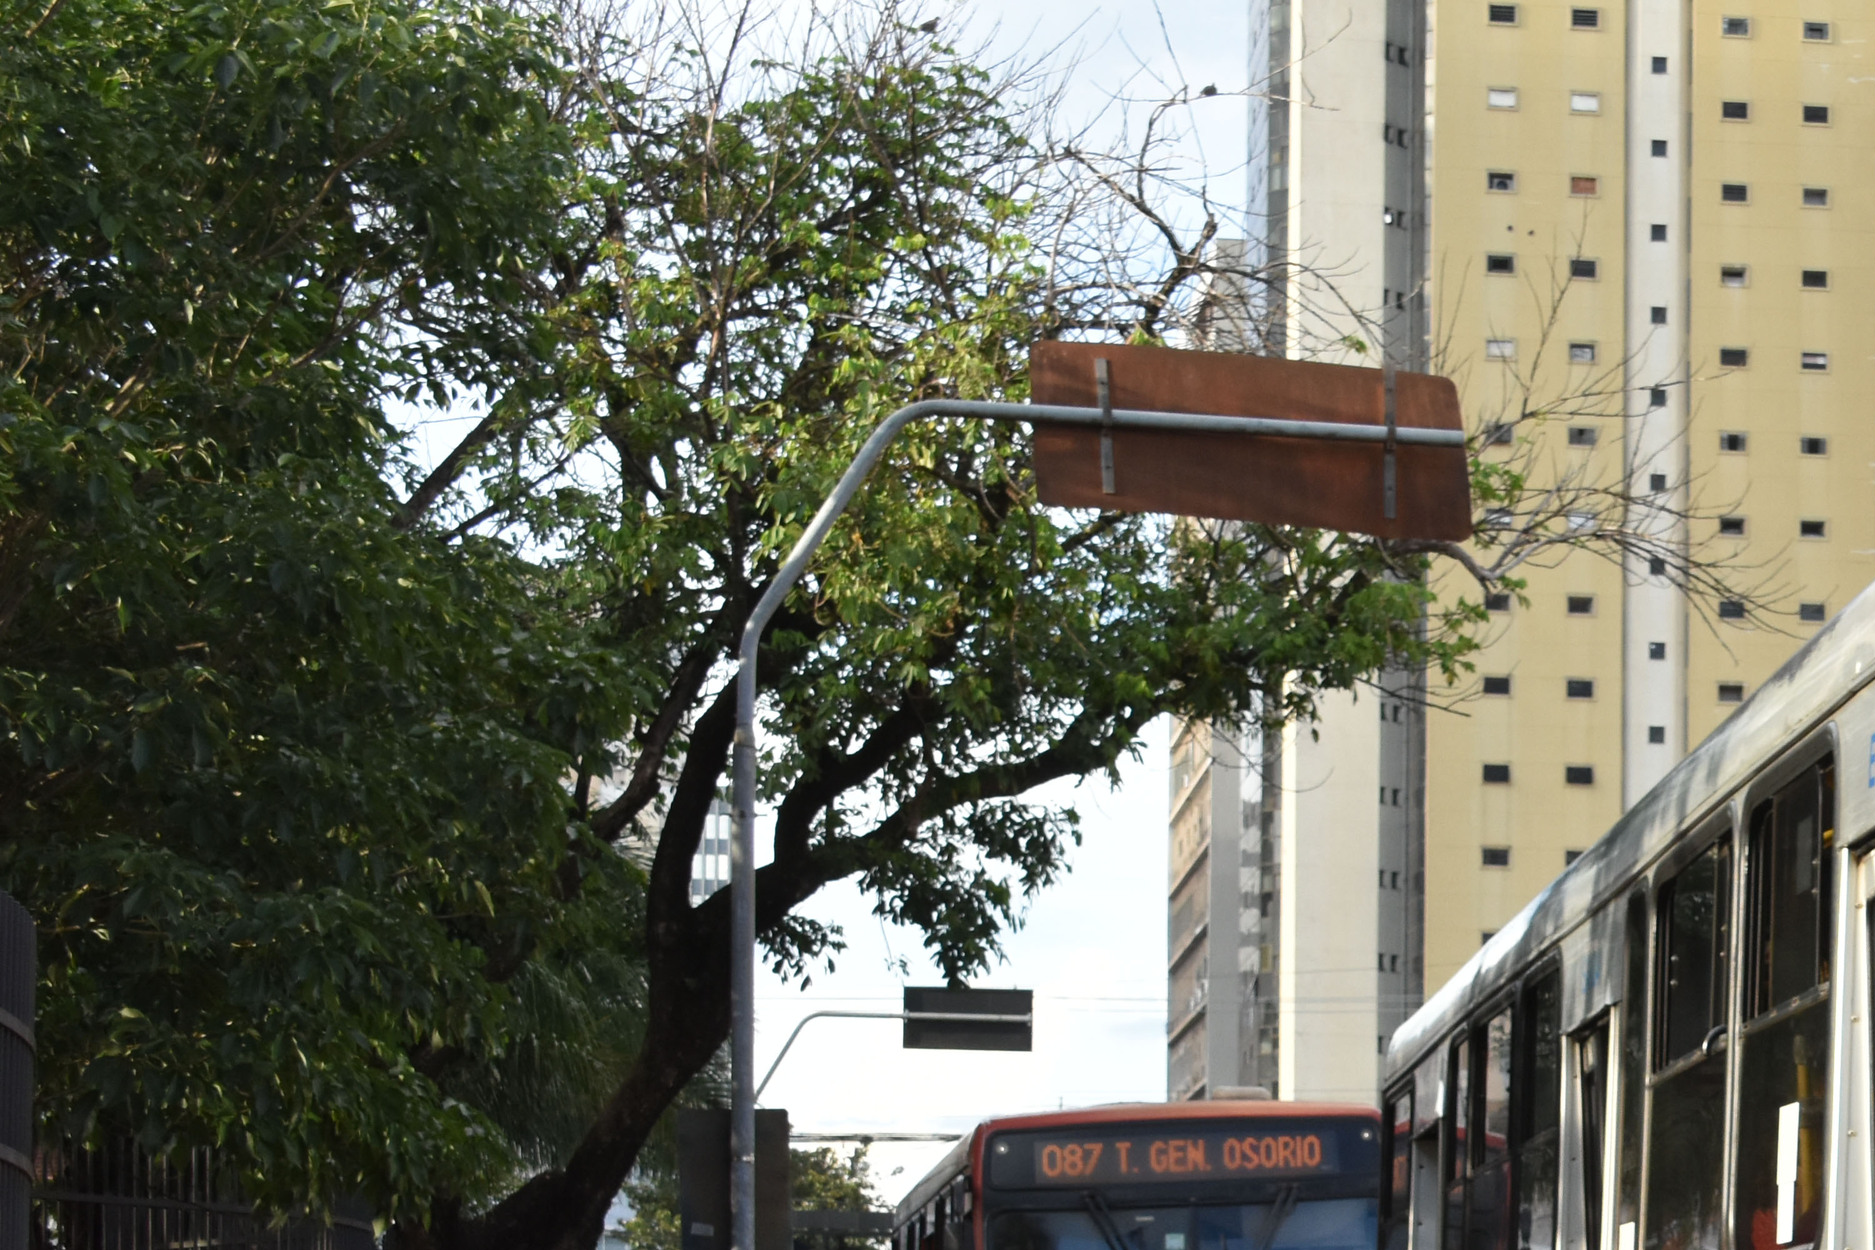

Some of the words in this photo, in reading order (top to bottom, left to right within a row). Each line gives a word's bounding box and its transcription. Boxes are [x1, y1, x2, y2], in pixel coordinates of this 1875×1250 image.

[1041, 1143, 1103, 1178] 087
[1115, 1142, 1139, 1174] T.
[1150, 1140, 1212, 1173] GEN.
[1223, 1134, 1322, 1170] OSORIO
